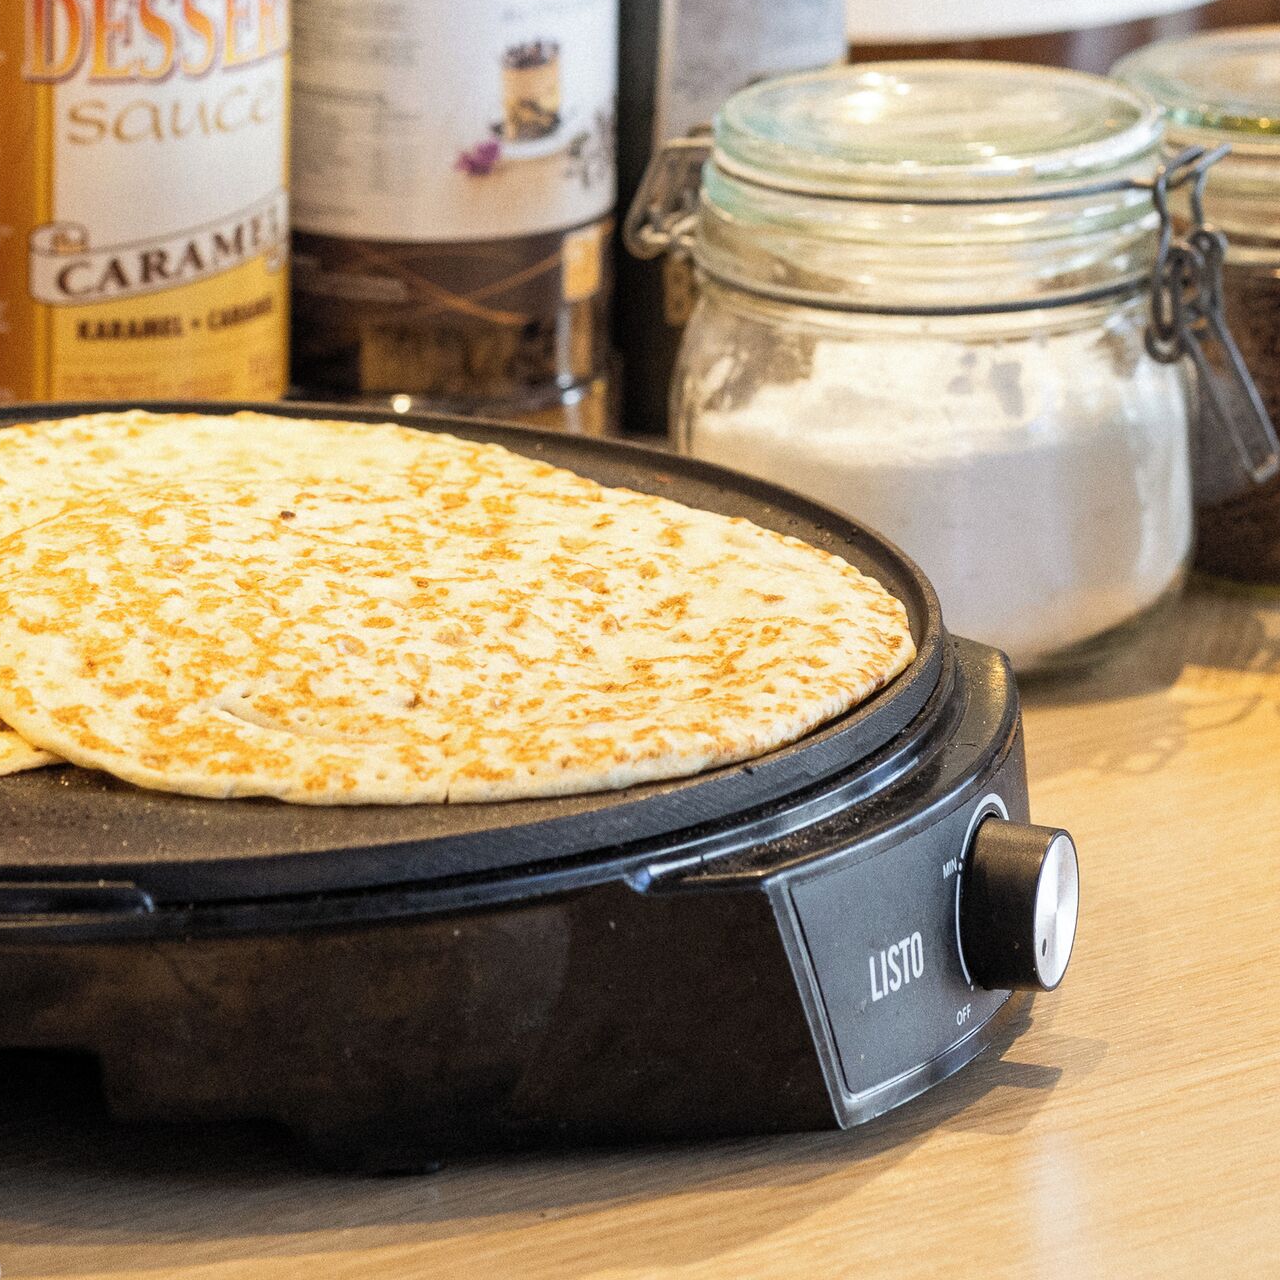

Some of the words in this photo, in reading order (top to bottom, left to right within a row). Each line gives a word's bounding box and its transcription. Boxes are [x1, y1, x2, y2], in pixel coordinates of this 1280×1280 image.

[942, 857, 958, 880] MIN
[870, 931, 924, 1001] LISTO
[956, 1003, 972, 1025] OFF
